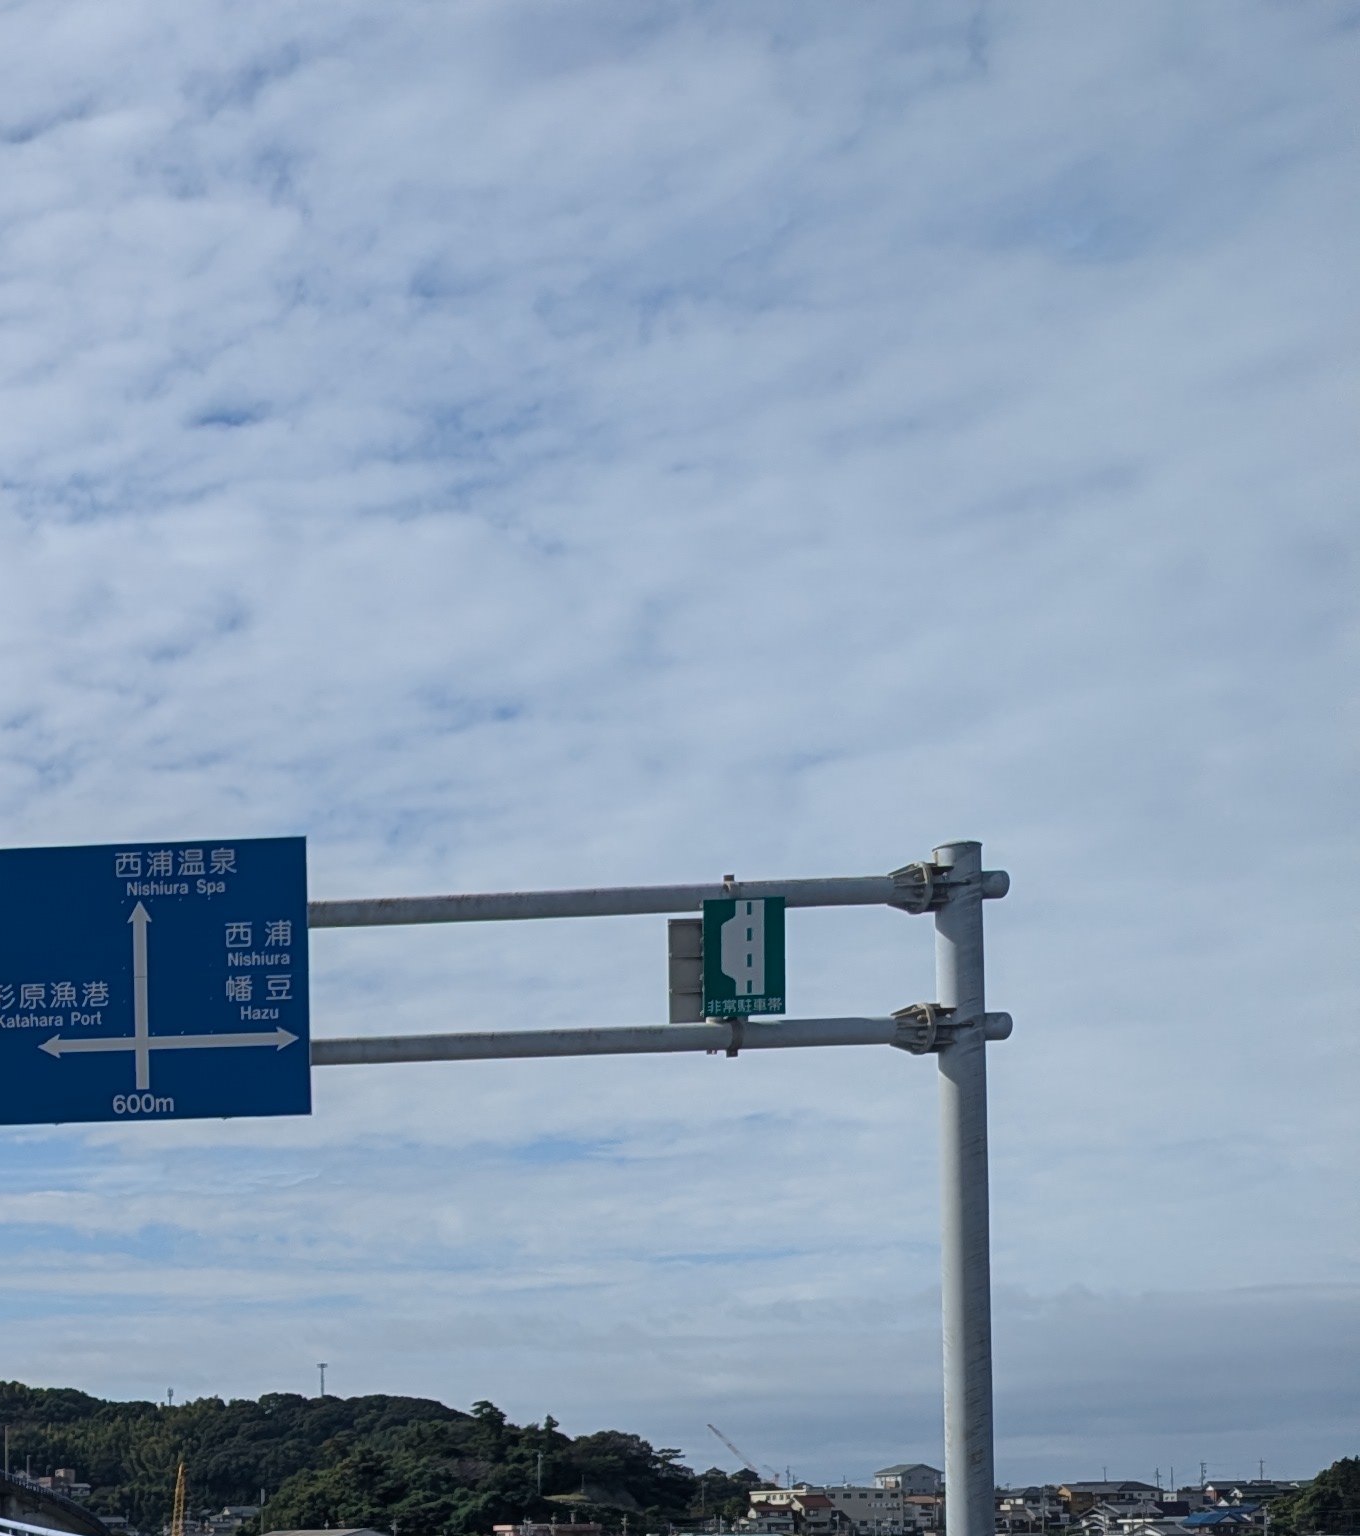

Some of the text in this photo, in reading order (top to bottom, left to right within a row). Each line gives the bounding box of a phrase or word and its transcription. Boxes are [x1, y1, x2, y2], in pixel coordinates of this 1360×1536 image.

[114, 848, 237, 878] 西浦温泉
[126, 879, 226, 896] Nishiura Spa
[227, 952, 290, 967] Nishiura
[240, 1006, 279, 1020] Hazu
[707, 997, 782, 1014] 非常駐車帯
[70, 1011, 102, 1026] Port
[112, 1093, 175, 1114] 600m
